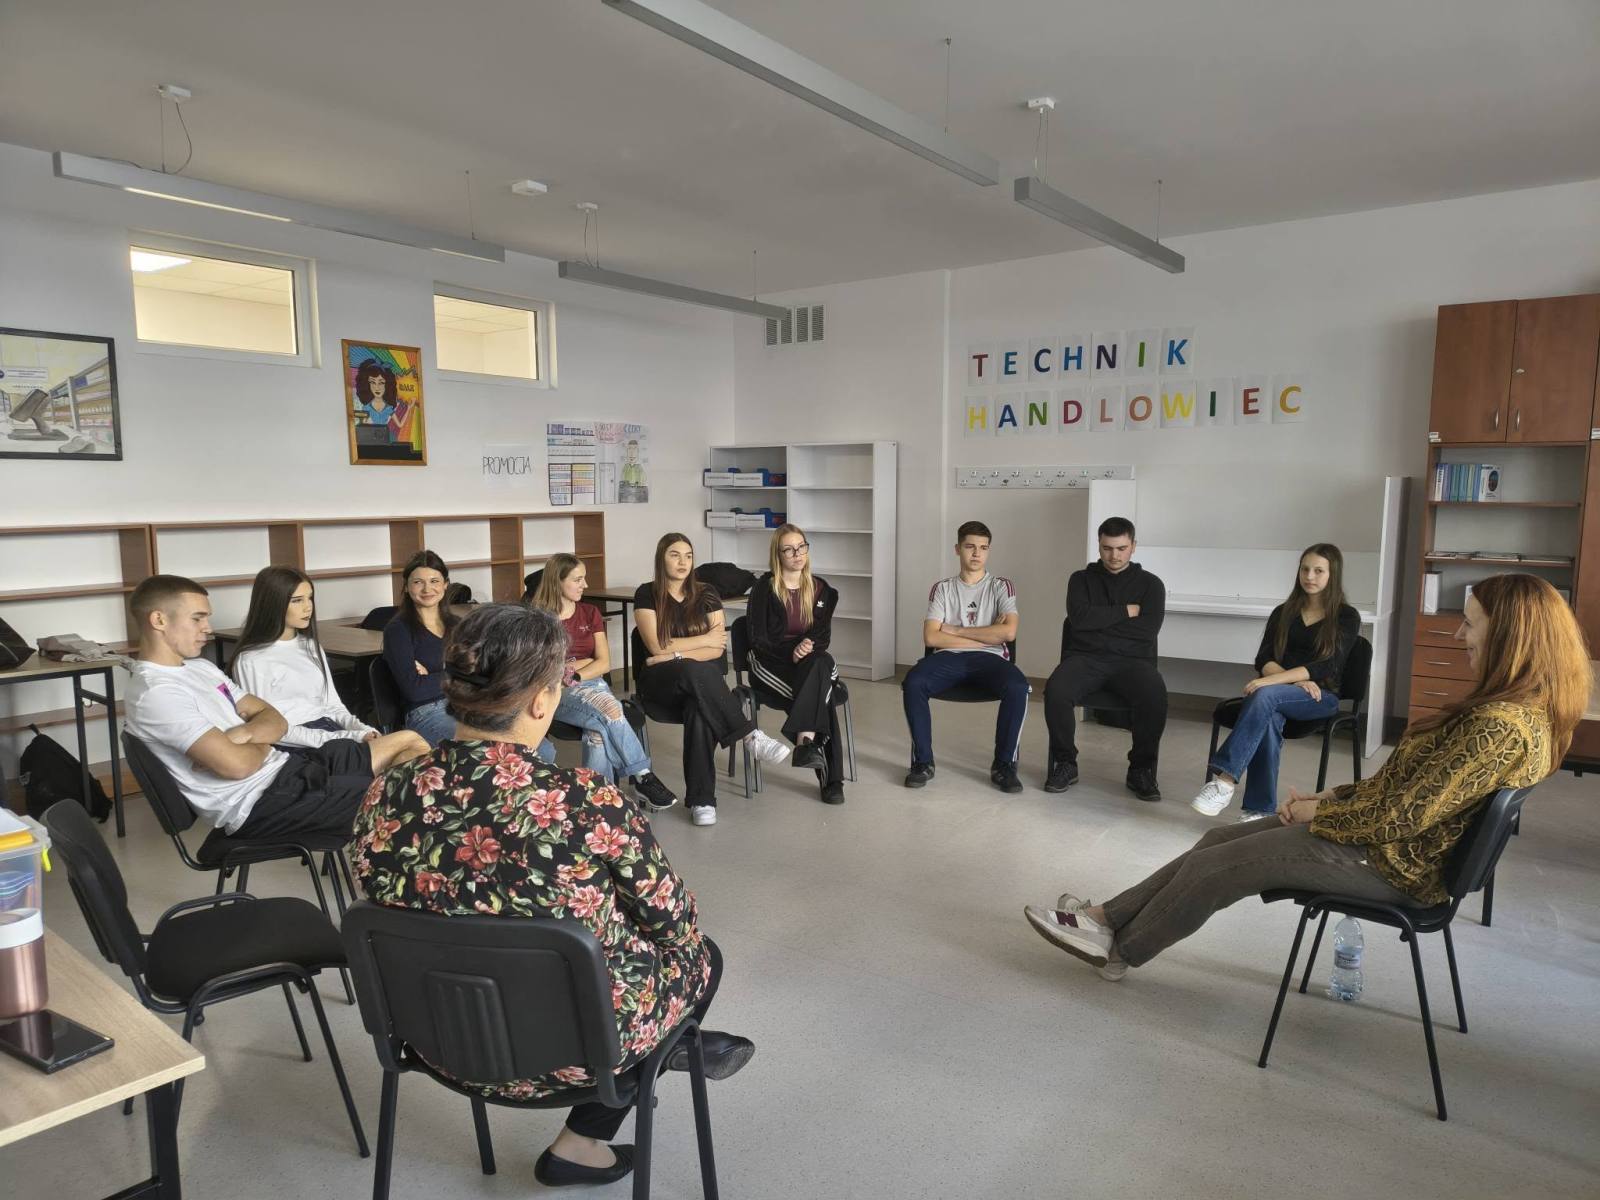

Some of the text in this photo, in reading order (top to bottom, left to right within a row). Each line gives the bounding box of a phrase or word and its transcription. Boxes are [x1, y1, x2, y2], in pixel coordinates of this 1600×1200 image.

[972, 338, 1188, 378] TECHNIK
[967, 384, 1303, 431] HANDLOWIEC
[482, 455, 532, 475] PROMOCJA
